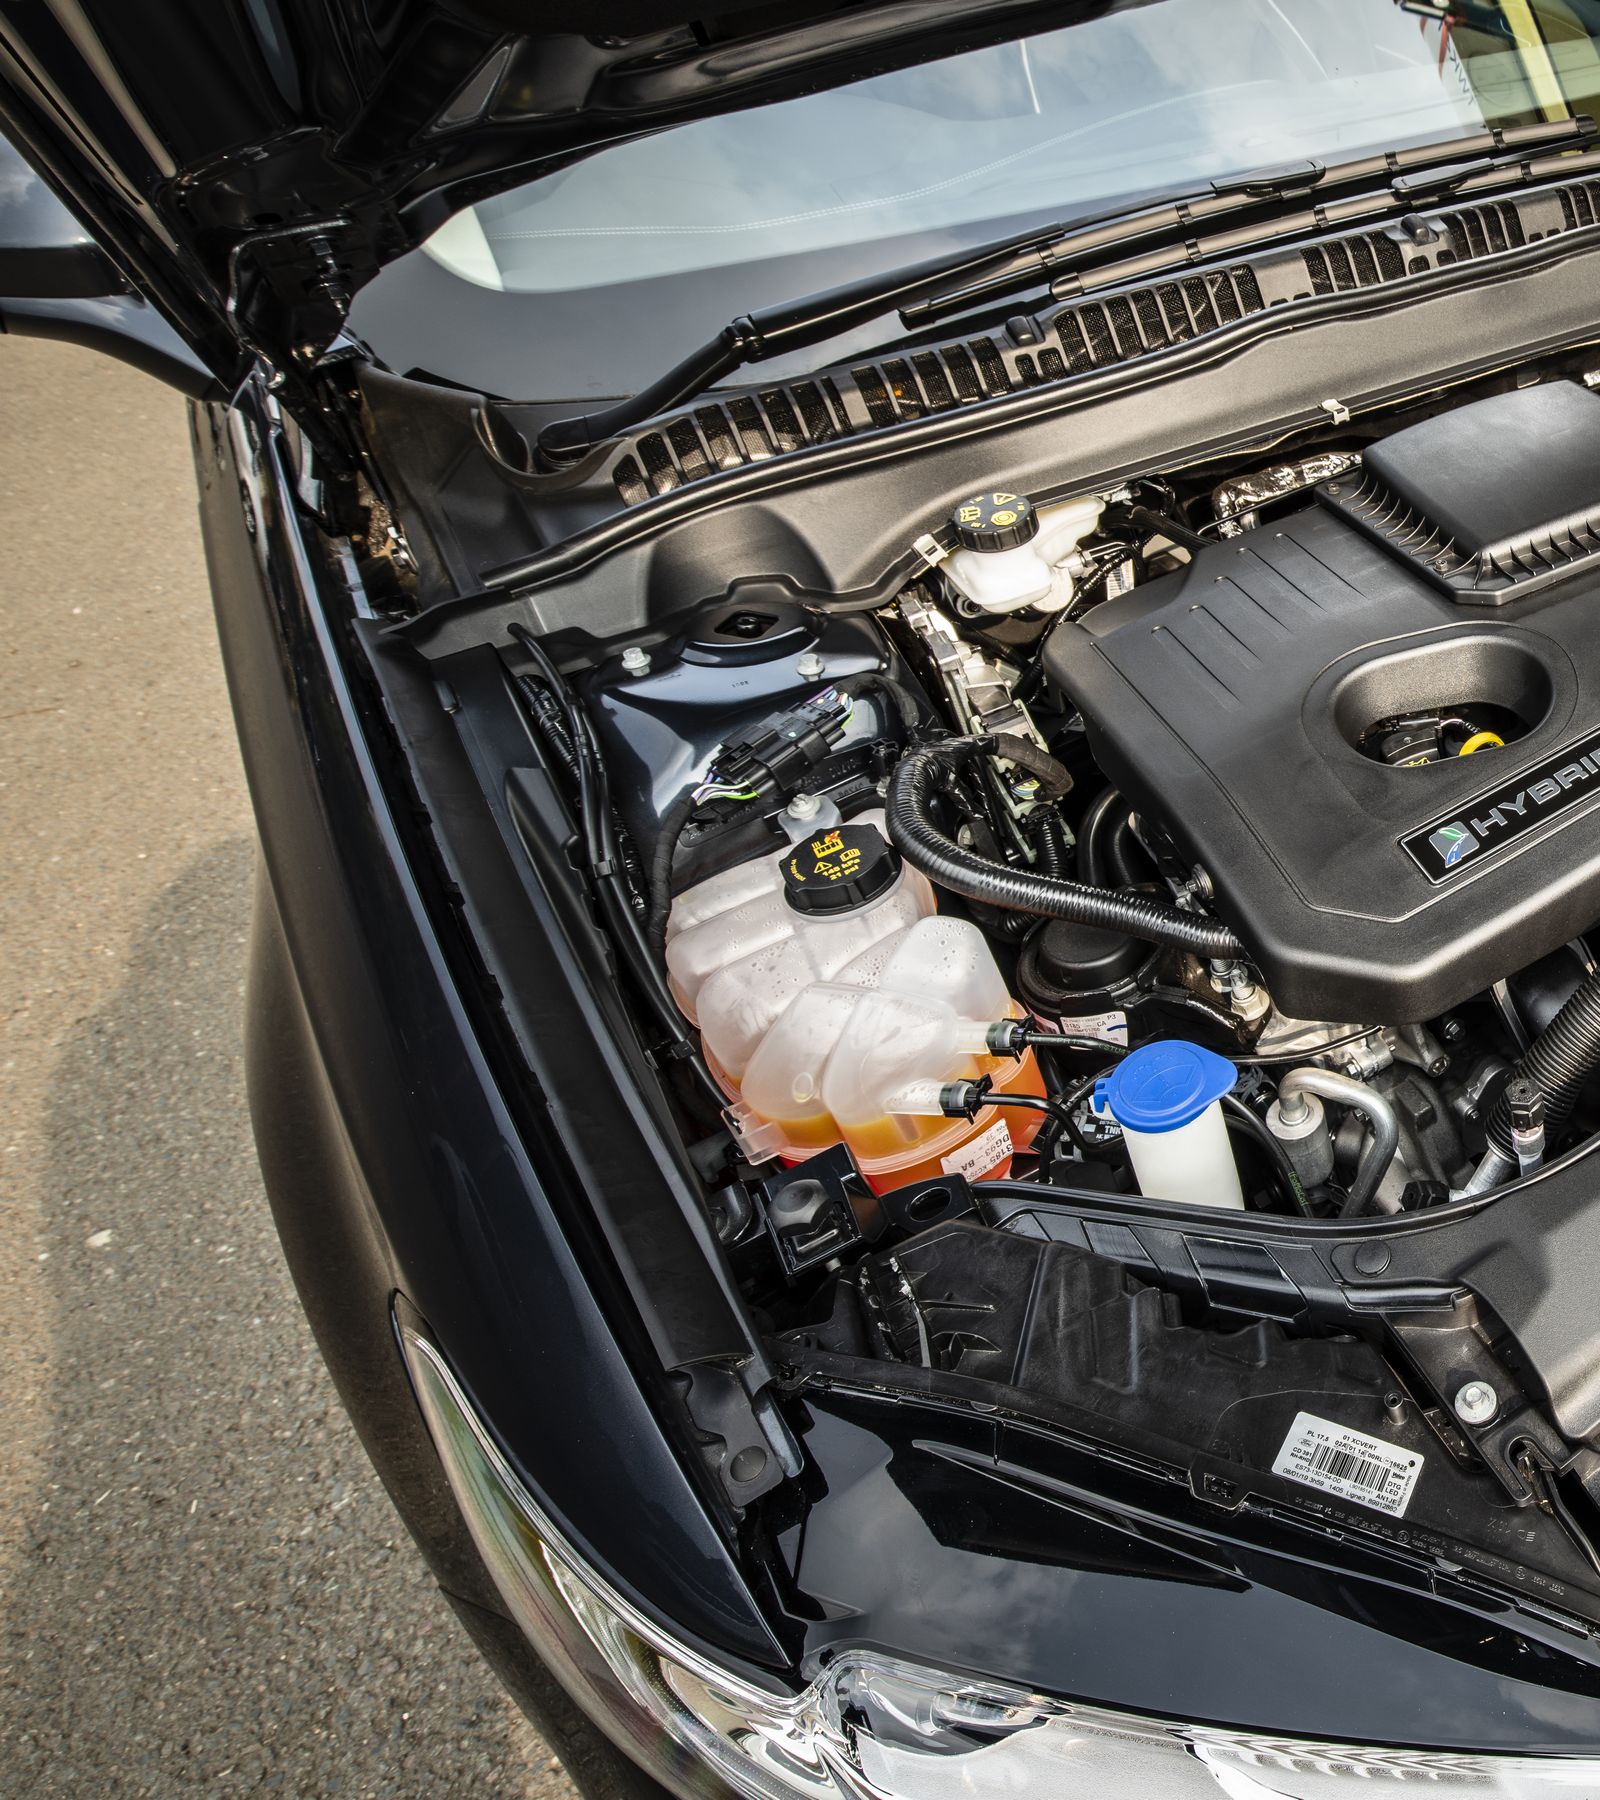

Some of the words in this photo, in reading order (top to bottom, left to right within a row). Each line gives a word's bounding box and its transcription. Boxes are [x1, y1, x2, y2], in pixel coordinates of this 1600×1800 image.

[990, 1144, 1013, 1164] 3185
[961, 1159, 975, 1171] BA
[1351, 1438, 1377, 1451] XCVERT
[1384, 1487, 1398, 1496] LED
[1387, 1481, 1401, 1490] DTG
